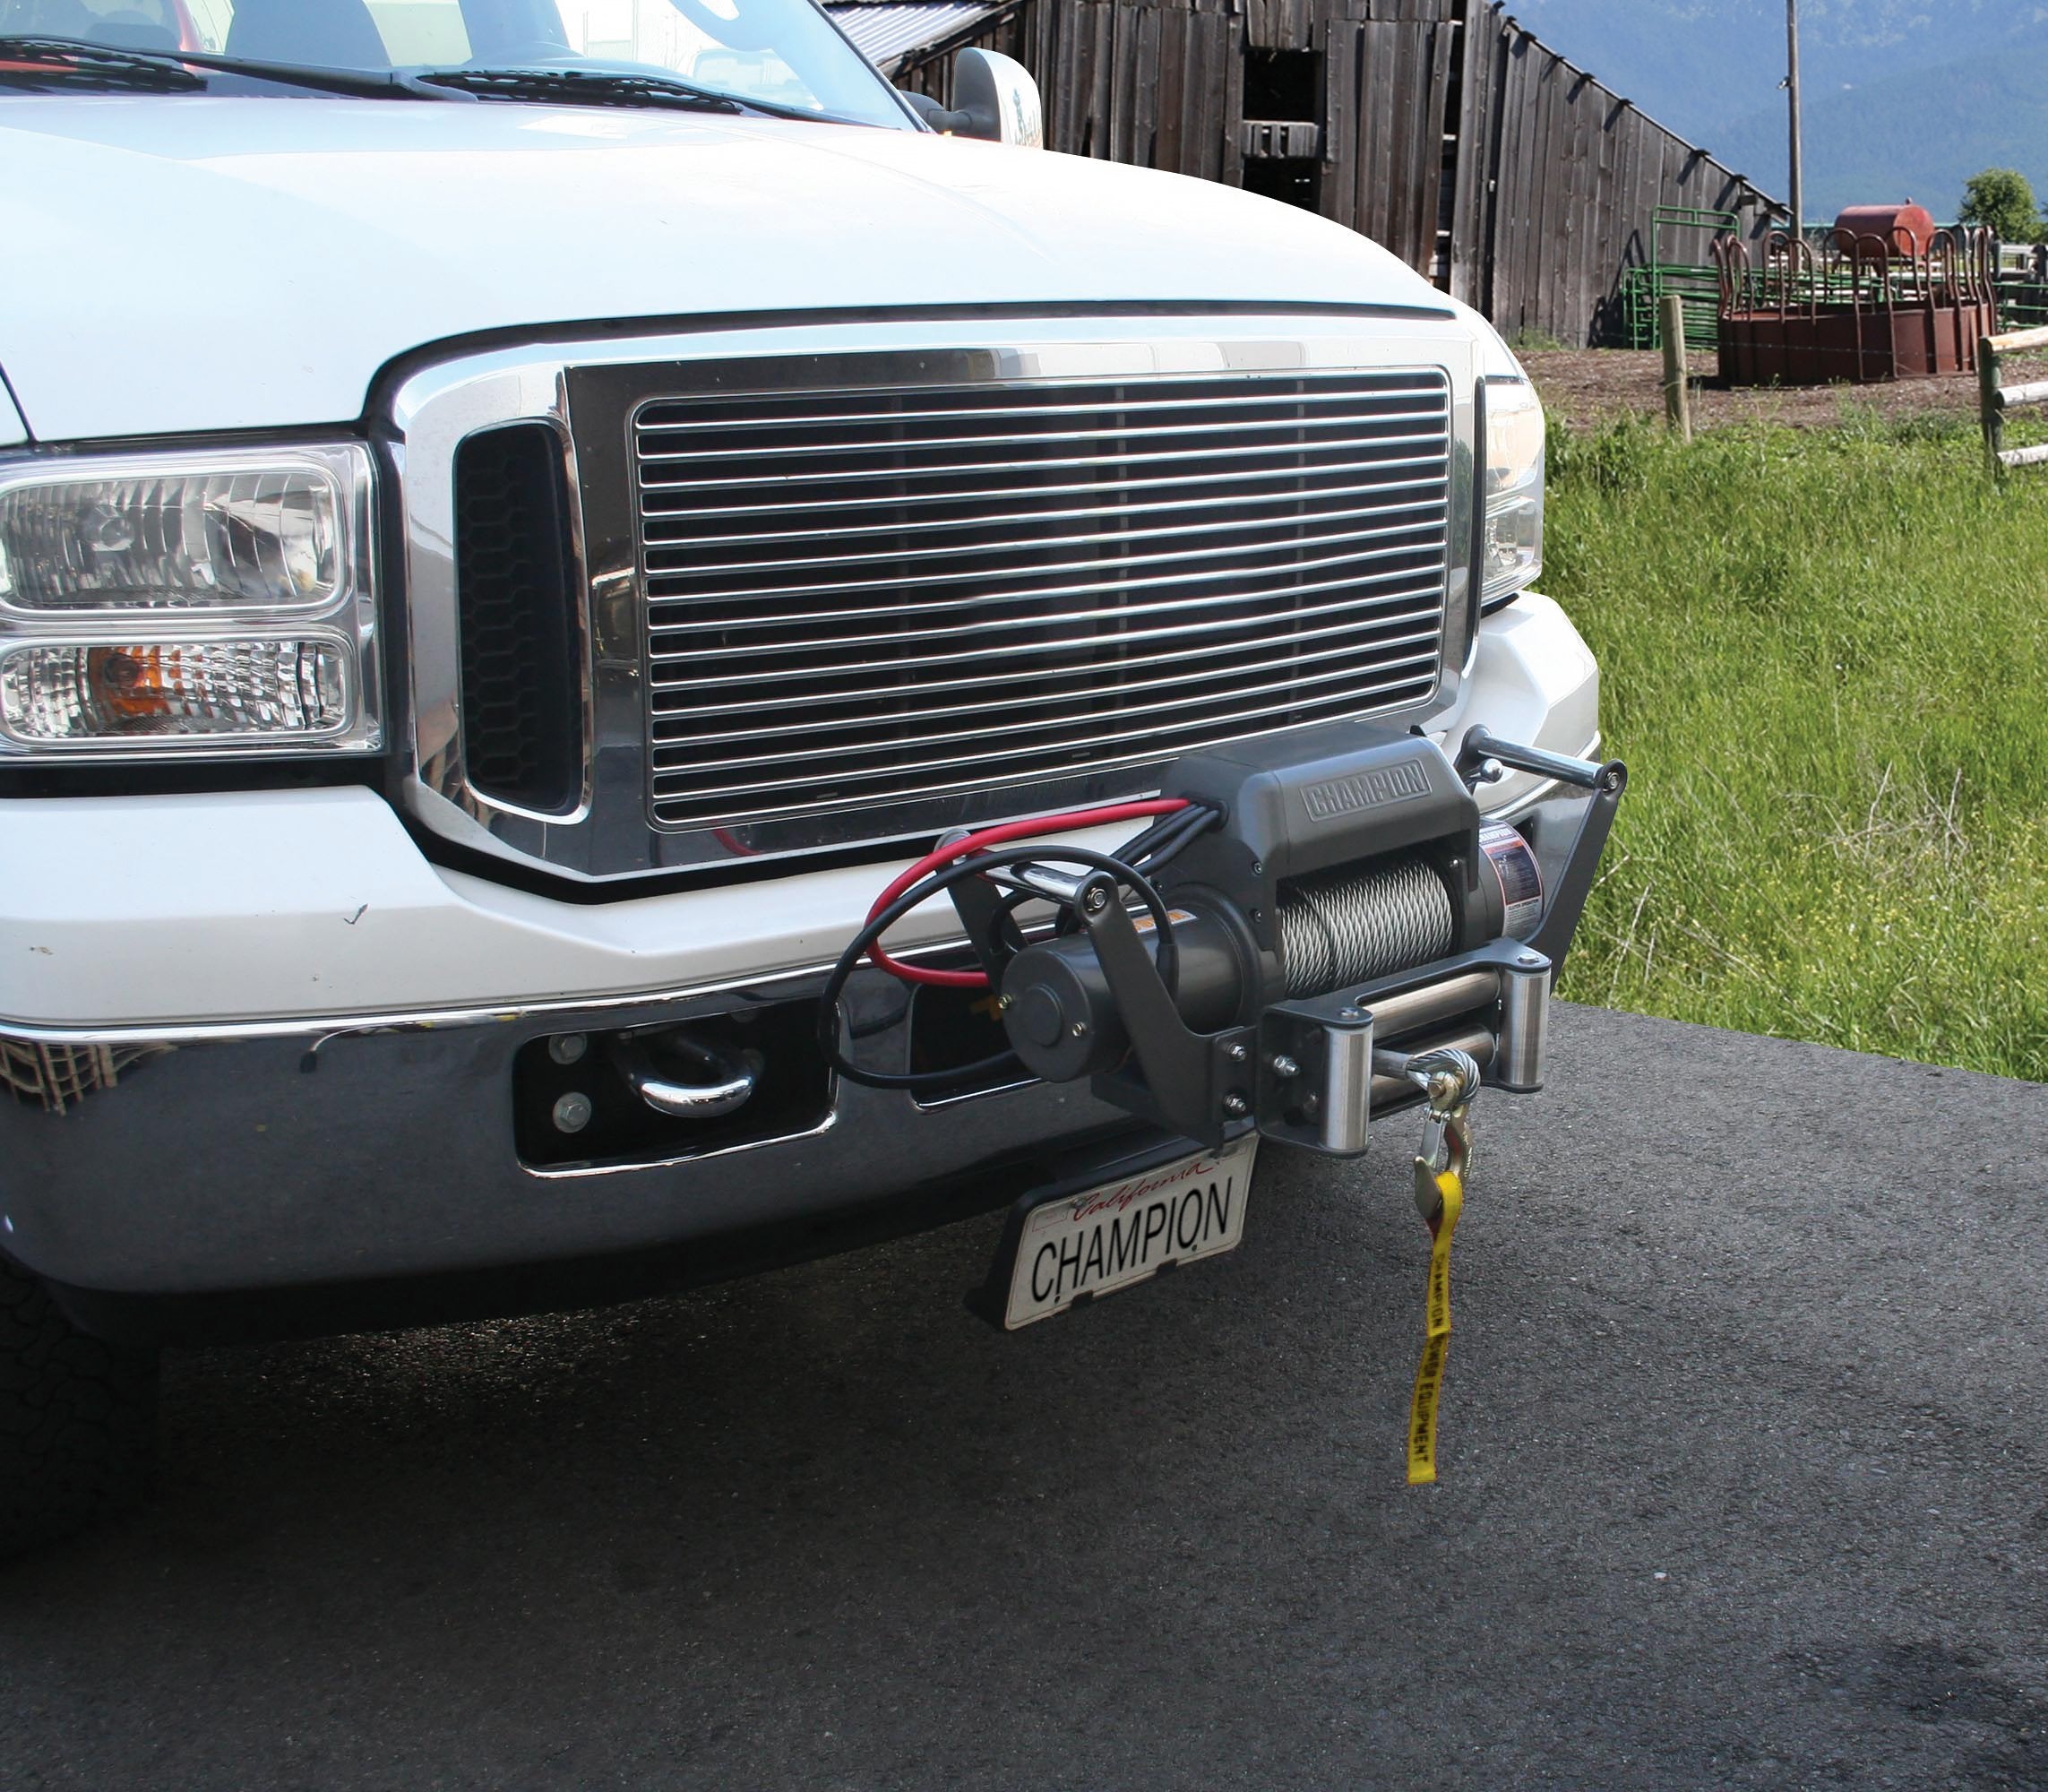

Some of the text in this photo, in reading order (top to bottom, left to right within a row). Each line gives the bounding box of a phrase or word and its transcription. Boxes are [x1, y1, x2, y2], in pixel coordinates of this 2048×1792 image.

[1309, 764, 1425, 816] CHAMPION
[1073, 1163, 1211, 1221] California
[1031, 1176, 1233, 1303] CHAMPION
[1432, 1254, 1445, 1328] CHAMPION
